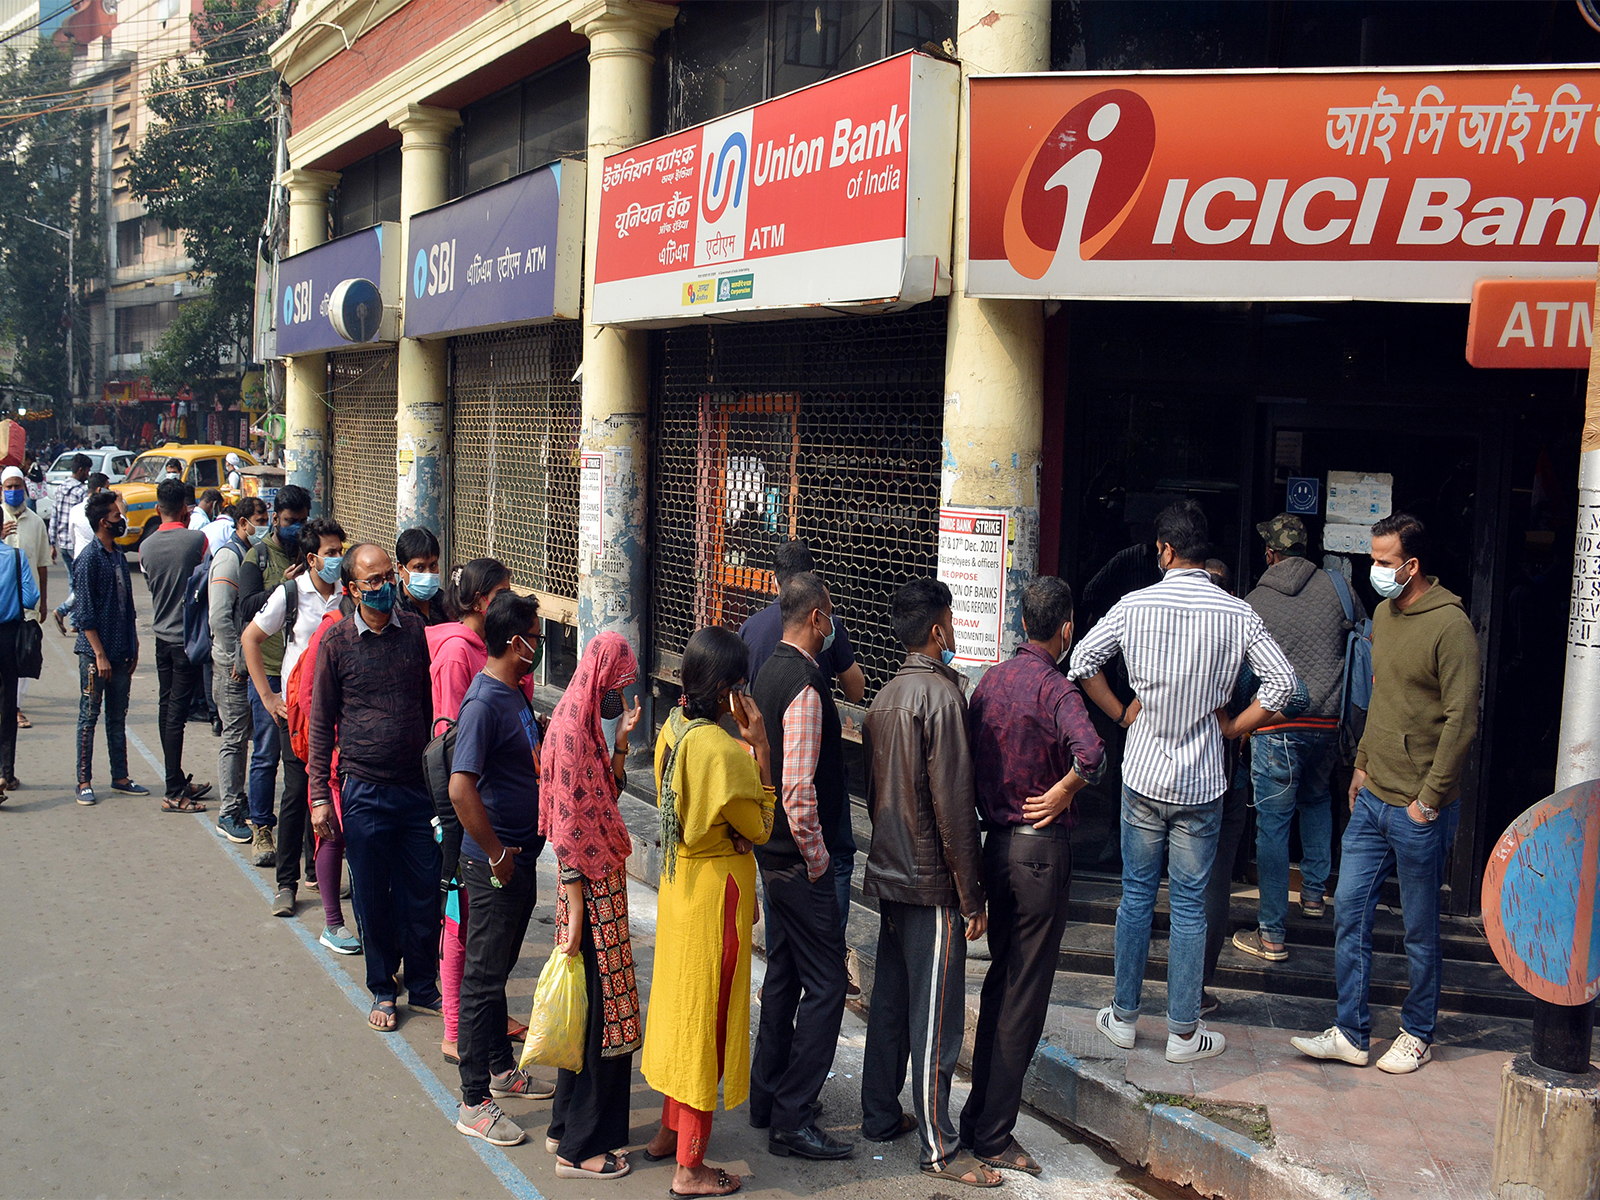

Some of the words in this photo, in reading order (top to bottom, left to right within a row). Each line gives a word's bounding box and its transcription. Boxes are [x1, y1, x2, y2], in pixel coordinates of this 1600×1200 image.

[753, 133, 825, 187] Union
[829, 104, 907, 168] Bank
[846, 175, 864, 199] of
[865, 168, 901, 195] India
[615, 202, 666, 239] यूनियन
[666, 191, 693, 219] बैंक
[1152, 177, 1389, 245] ICICI
[705, 231, 737, 260] एटीएम
[749, 223, 786, 252] ATM
[497, 246, 521, 283] एटीएम
[524, 245, 547, 274] ATM
[658, 239, 690, 266] এটিএম
[427, 239, 456, 296] SBI
[467, 253, 493, 286] এটিএম
[293, 279, 313, 325] SBI
[956, 519, 972, 533] BANK
[975, 520, 1001, 534] STRIKE
[965, 539, 979, 552] Dec.
[980, 540, 998, 553] 2021
[947, 555, 971, 568] employees
[971, 557, 977, 567] &
[977, 558, 999, 569] officers
[950, 570, 978, 581] OPPOSE
[964, 585, 973, 597] OF
[974, 585, 998, 599] BANKS
[952, 599, 970, 613] ANKING
[971, 600, 997, 615] REFORMS
[952, 617, 980, 628] DRAW
[954, 630, 984, 643] MENDMENT)
[985, 633, 996, 643] BILL
[958, 645, 973, 655] BANK
[974, 646, 996, 657] UNIONS
